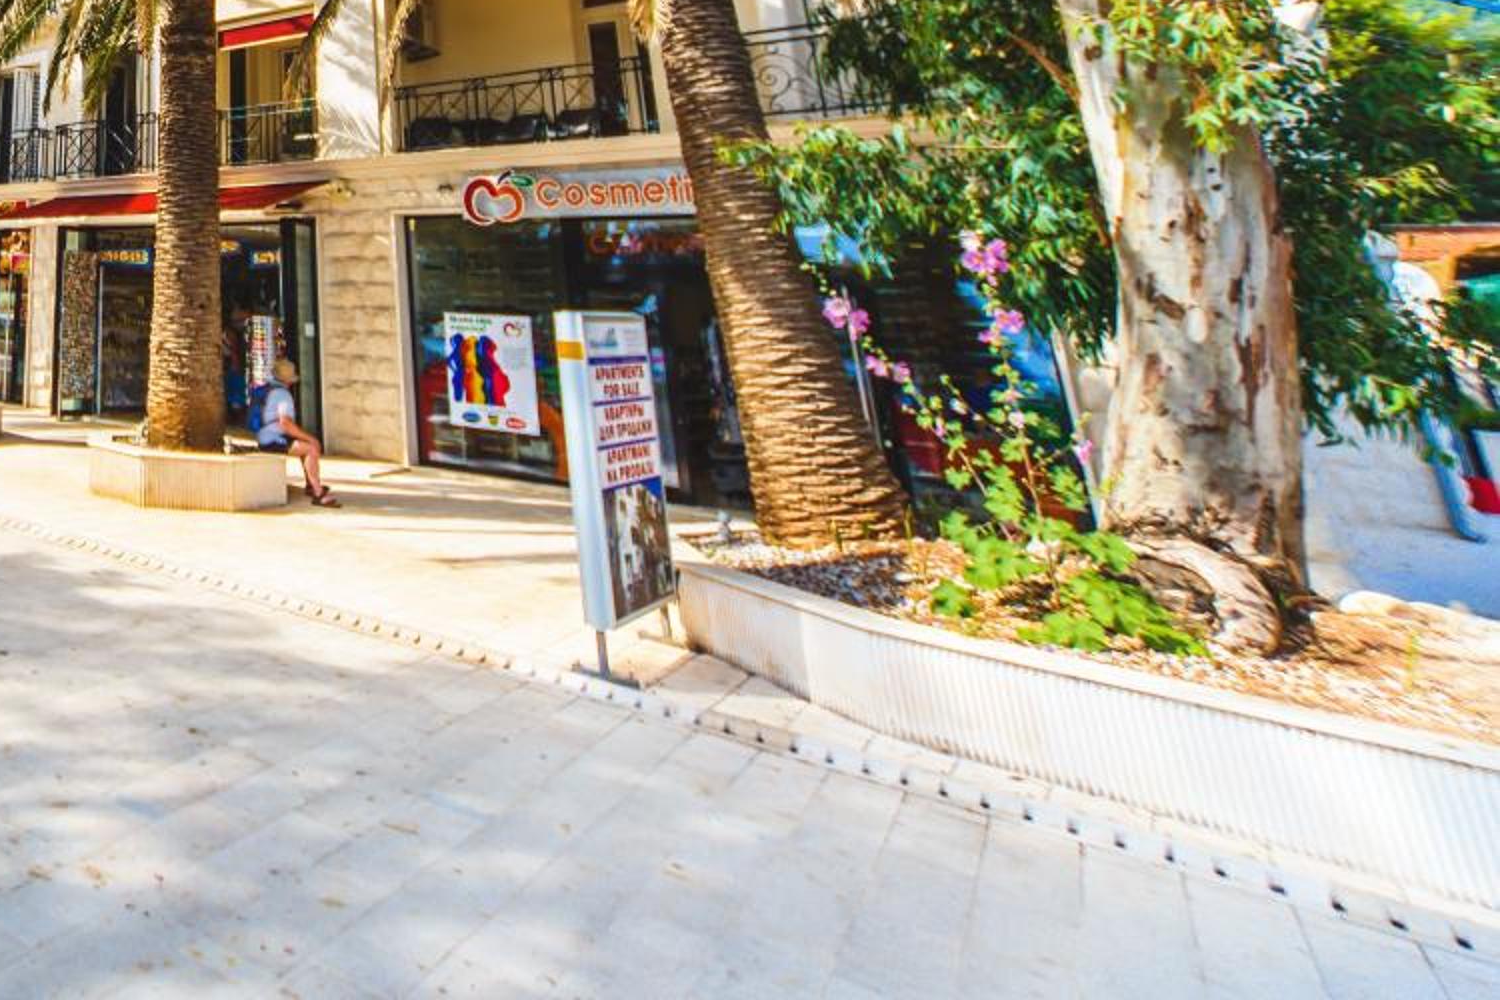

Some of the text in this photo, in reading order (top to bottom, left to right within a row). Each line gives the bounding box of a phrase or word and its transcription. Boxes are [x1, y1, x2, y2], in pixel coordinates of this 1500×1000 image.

[595, 366, 644, 380] APARTMENTS
[603, 381, 640, 397] FOR SALE
